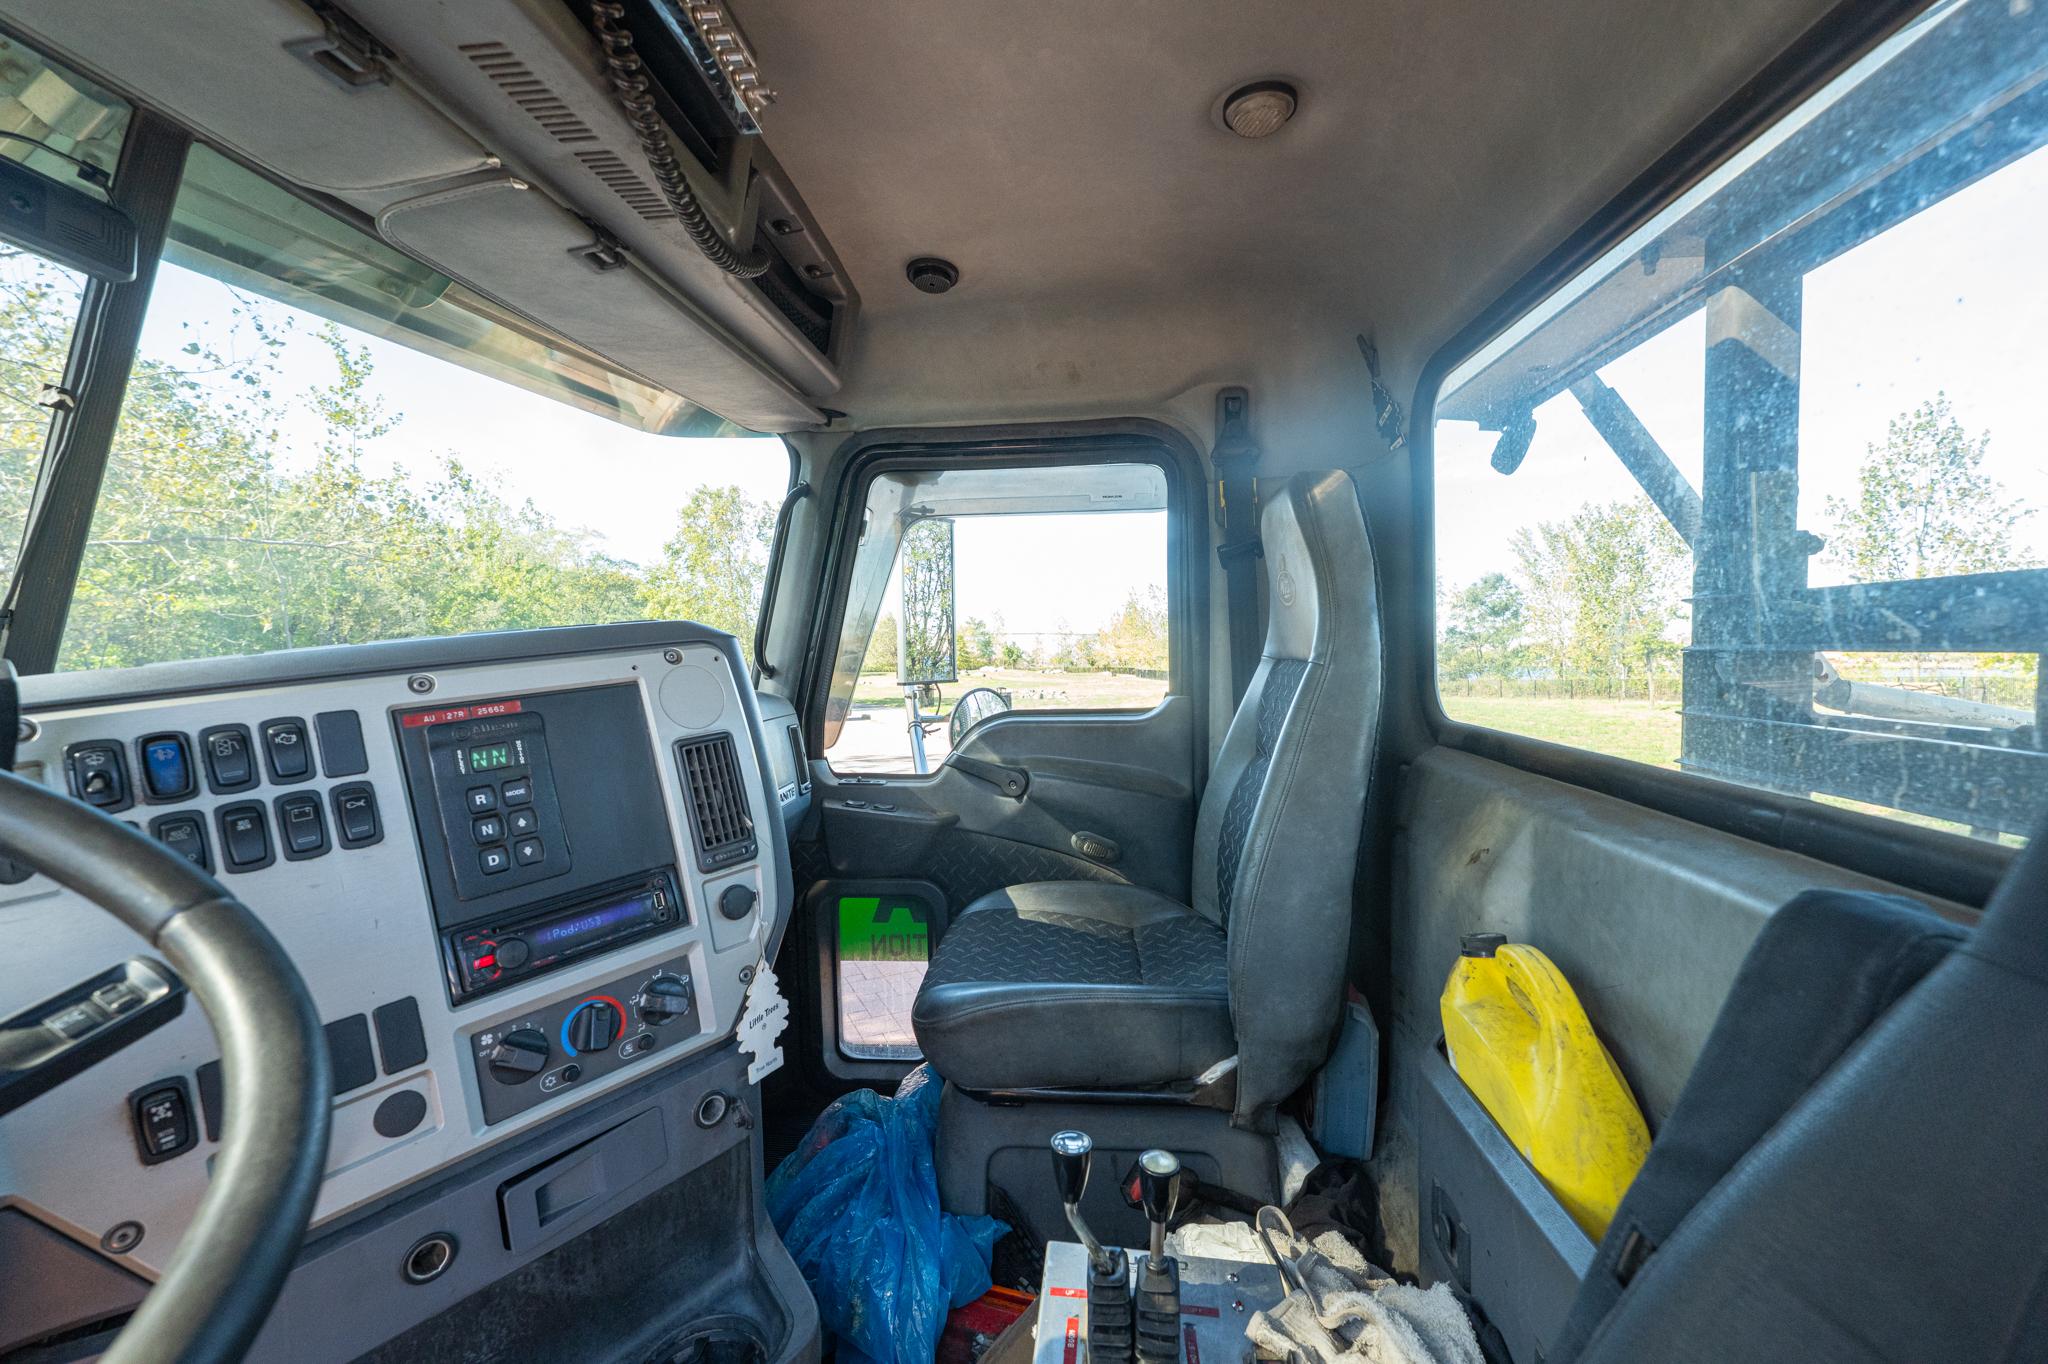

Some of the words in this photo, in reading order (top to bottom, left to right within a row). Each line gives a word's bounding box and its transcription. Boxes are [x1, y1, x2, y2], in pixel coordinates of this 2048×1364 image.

[423, 715, 436, 723] AU
[505, 787, 526, 797] MODE
[474, 794, 487, 805] R
[481, 824, 494, 836] N
[487, 854, 500, 867] D
[748, 1012, 765, 1030] Little
[764, 1002, 780, 1017] Trees
